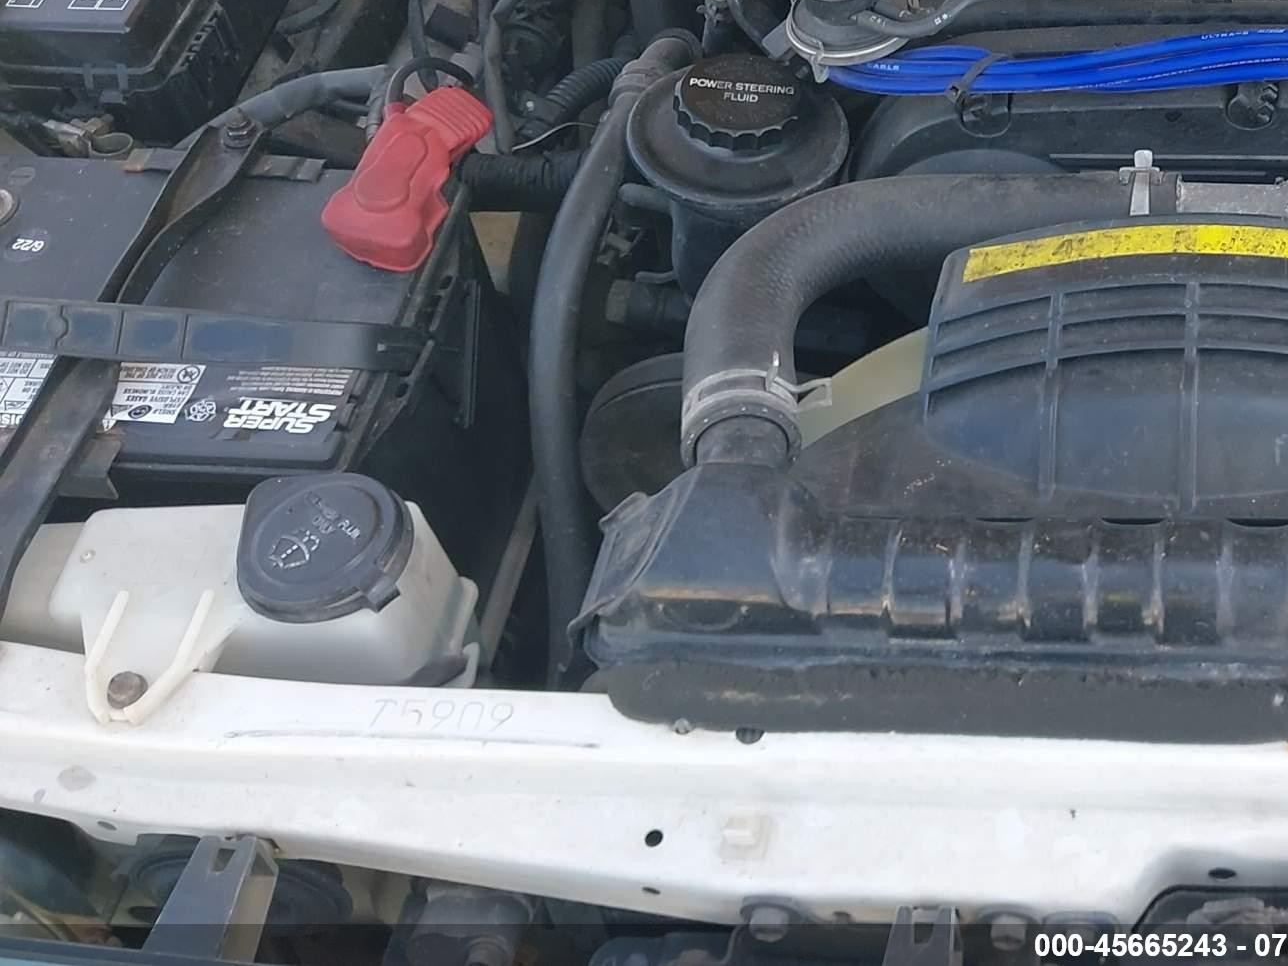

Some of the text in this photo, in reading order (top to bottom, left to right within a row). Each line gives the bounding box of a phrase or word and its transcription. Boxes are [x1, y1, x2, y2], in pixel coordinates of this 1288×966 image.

[689, 77, 794, 95] POWER STEERING
[723, 91, 759, 103] FLUID
[12, 237, 45, 252] 6/22
[228, 397, 337, 423] START
[223, 414, 314, 434] SUPER
